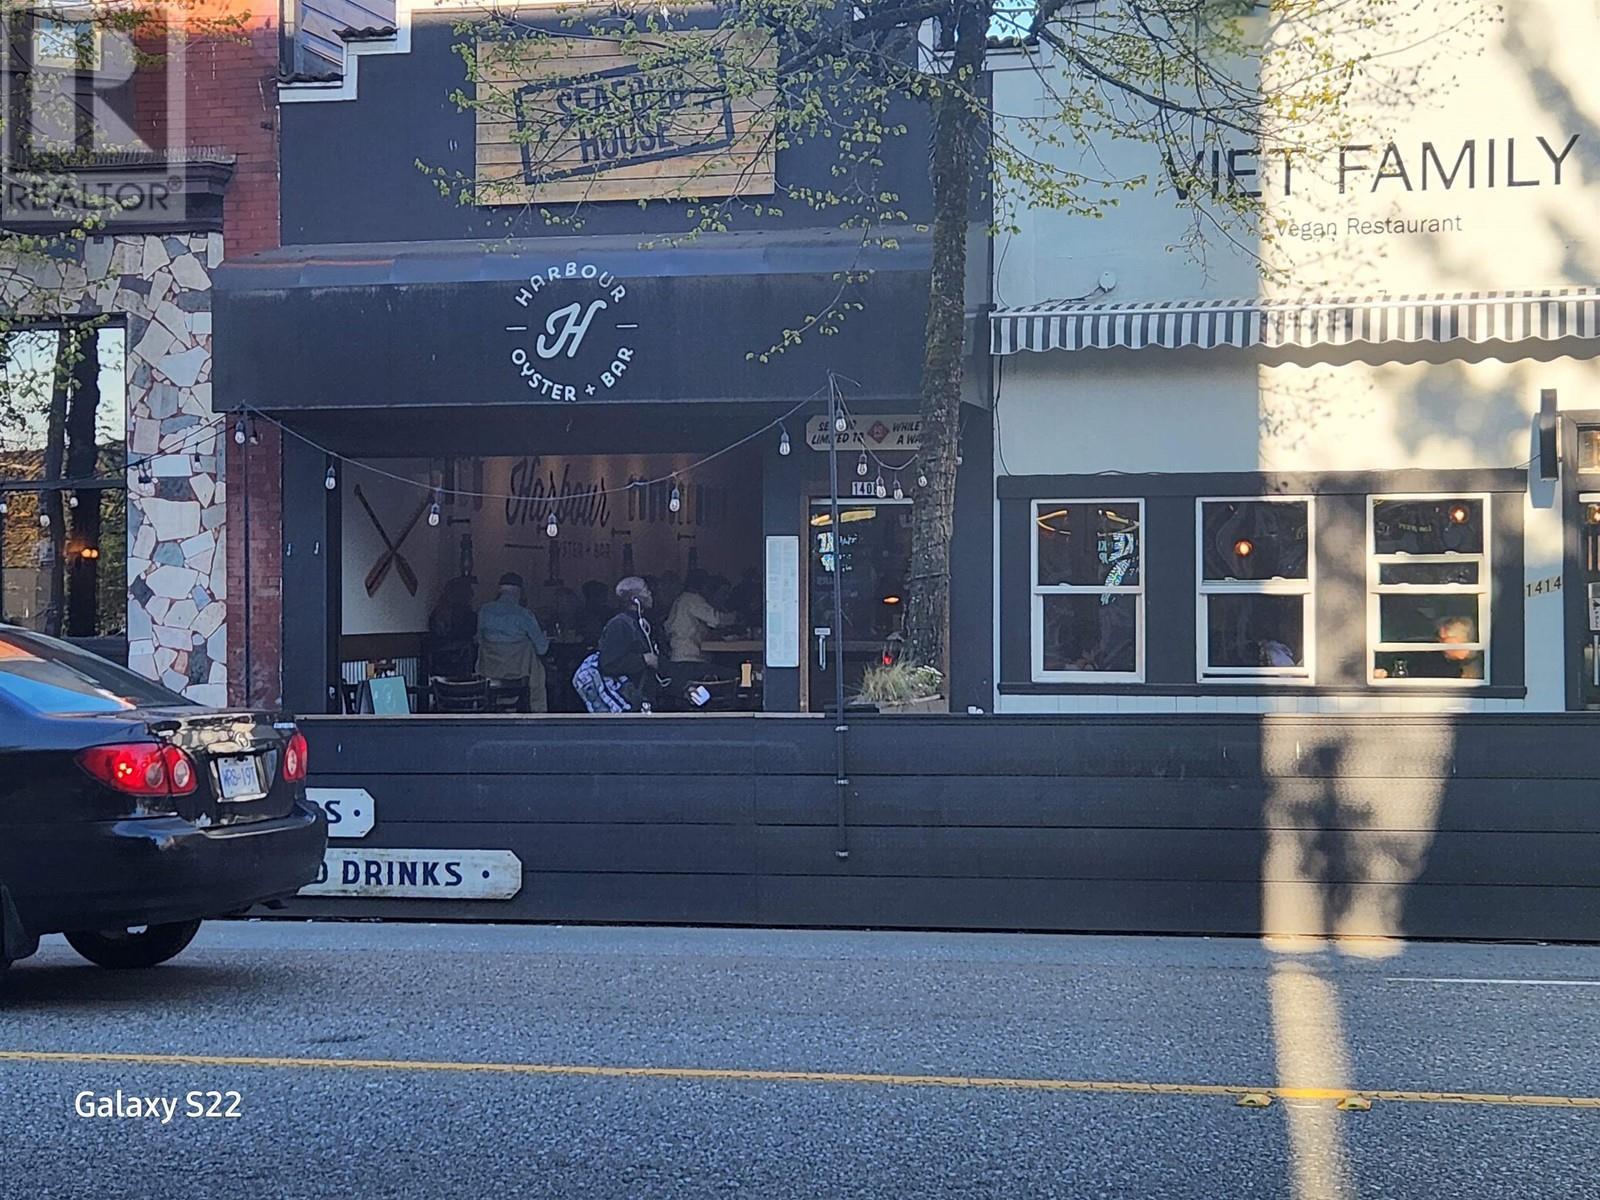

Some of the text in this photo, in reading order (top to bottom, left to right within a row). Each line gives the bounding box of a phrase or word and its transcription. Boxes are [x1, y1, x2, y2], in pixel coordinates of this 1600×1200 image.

[577, 115, 674, 163] HOUSE
[1162, 134, 1580, 200] VIET FAMILY
[1347, 215, 1462, 235] Restaurant
[515, 262, 626, 307] HARBOUR
[511, 349, 577, 401] OYSTER
[600, 347, 634, 388] BAR
[853, 482, 877, 495] 140
[1526, 576, 1562, 597] 1414
[342, 860, 462, 887] DRINKS
